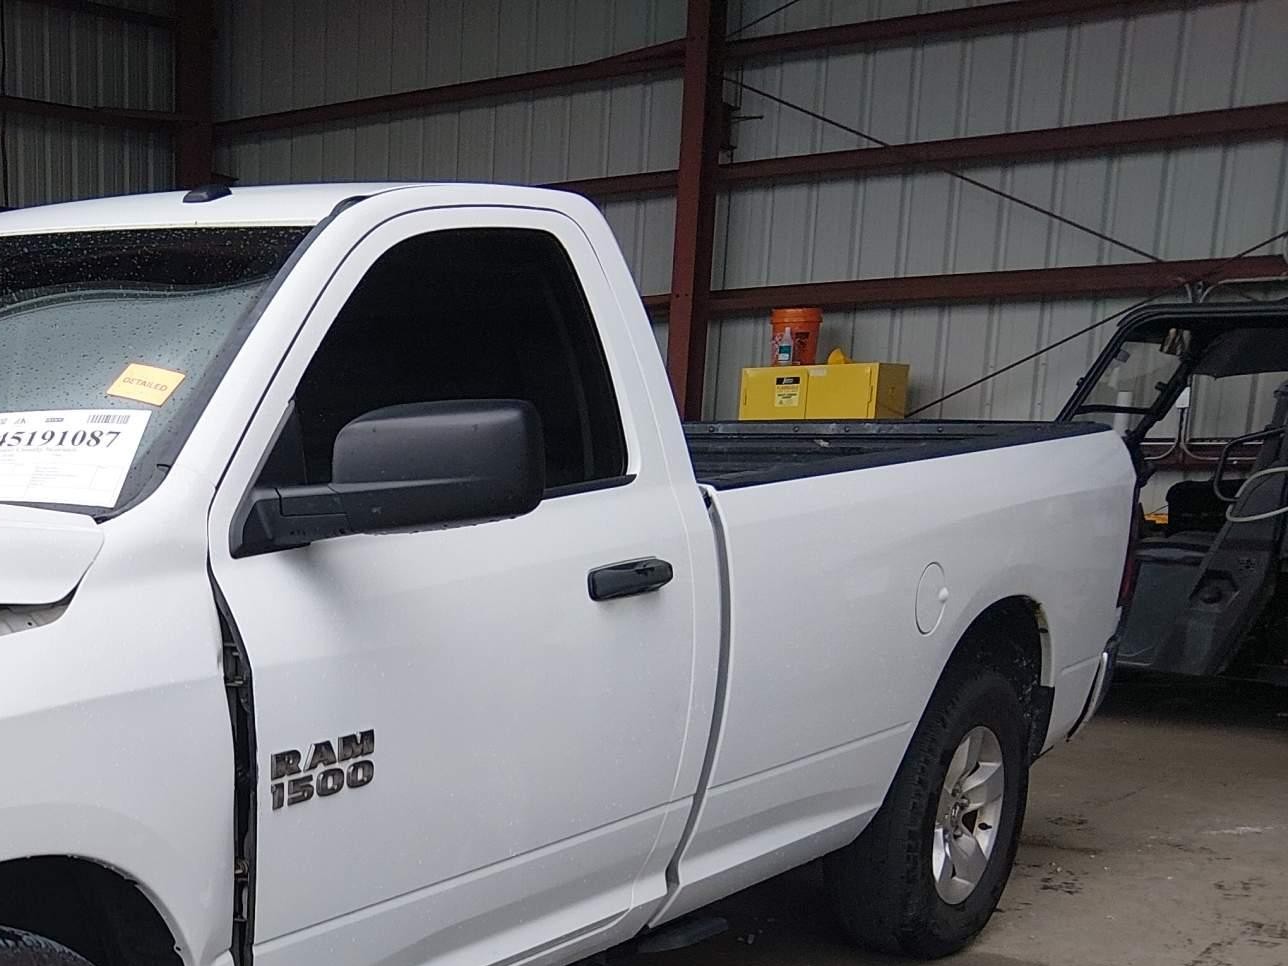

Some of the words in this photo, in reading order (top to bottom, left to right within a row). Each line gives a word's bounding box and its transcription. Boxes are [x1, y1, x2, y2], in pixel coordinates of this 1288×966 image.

[122, 376, 168, 392] DETAILED
[270, 728, 375, 780] RAM
[270, 760, 375, 811] 1500
